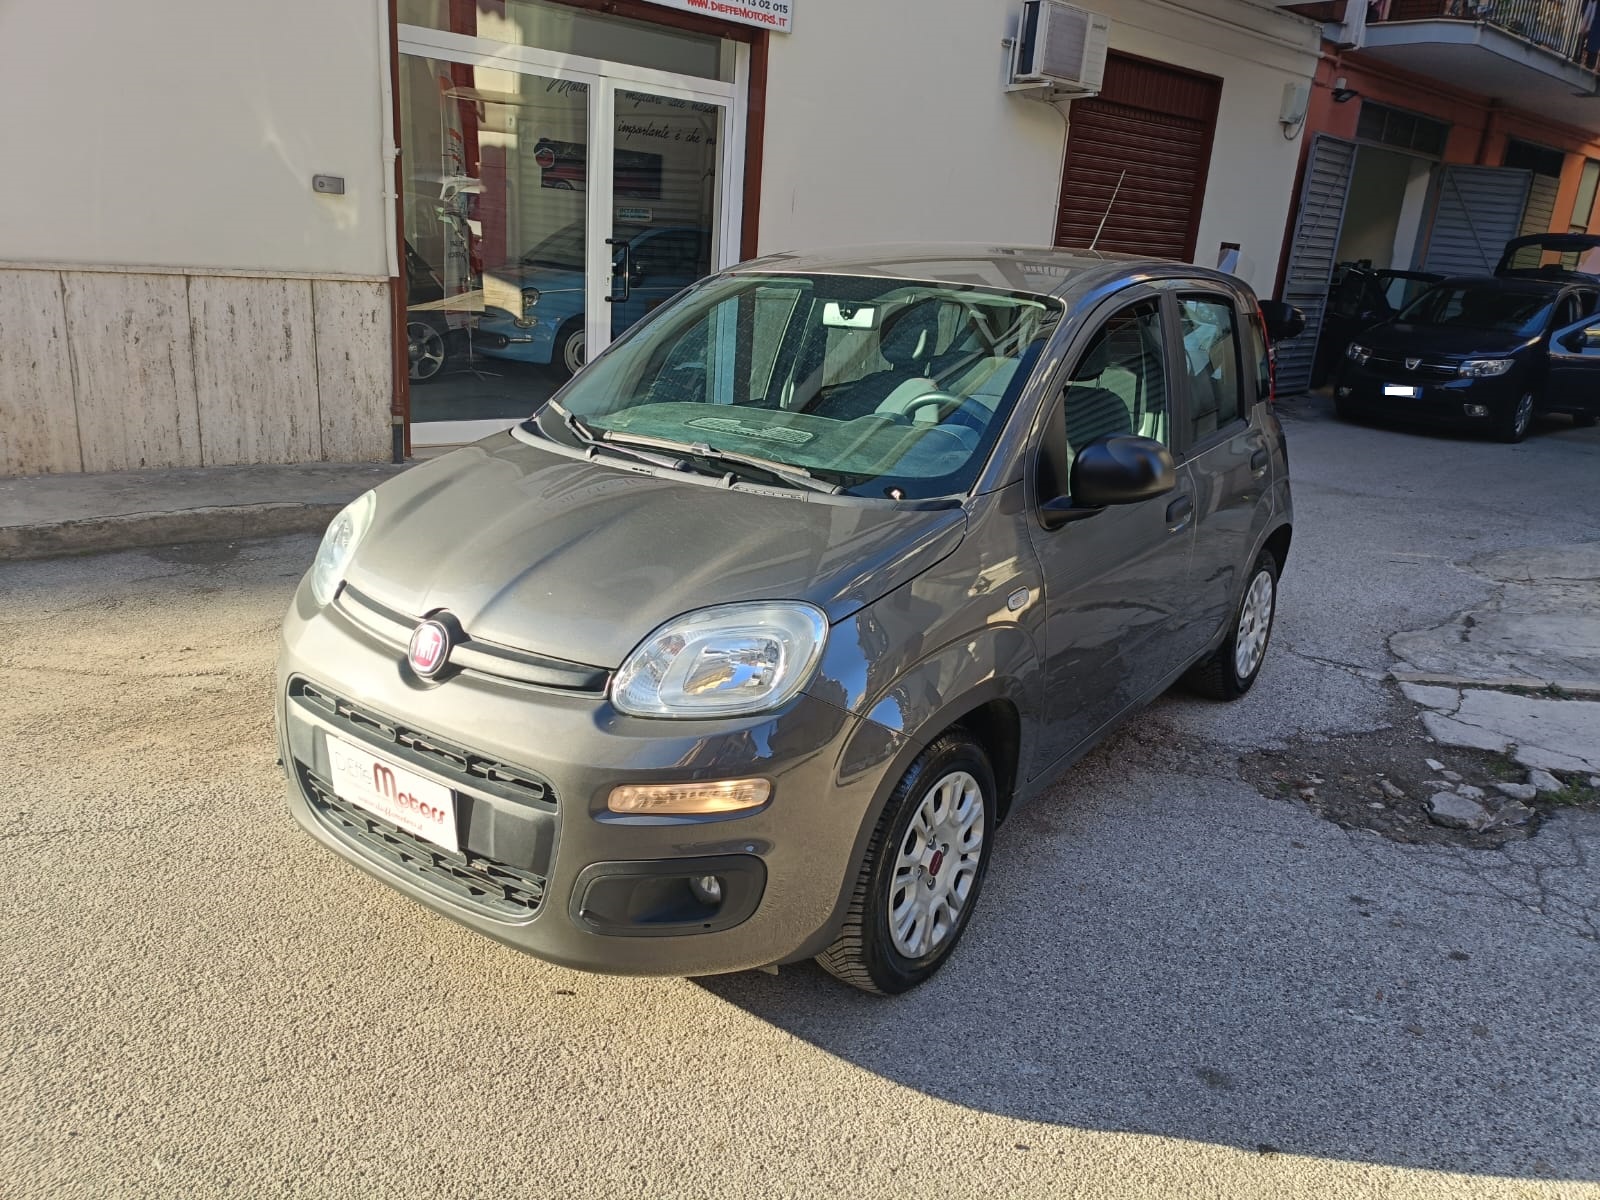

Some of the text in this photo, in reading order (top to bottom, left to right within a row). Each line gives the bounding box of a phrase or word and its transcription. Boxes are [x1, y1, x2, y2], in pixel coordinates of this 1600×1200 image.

[758, 0, 771, 10] 02
[772, 3, 788, 14] 015
[617, 120, 670, 141] importante
[686, 127, 702, 144] che
[373, 762, 446, 824] Motors
